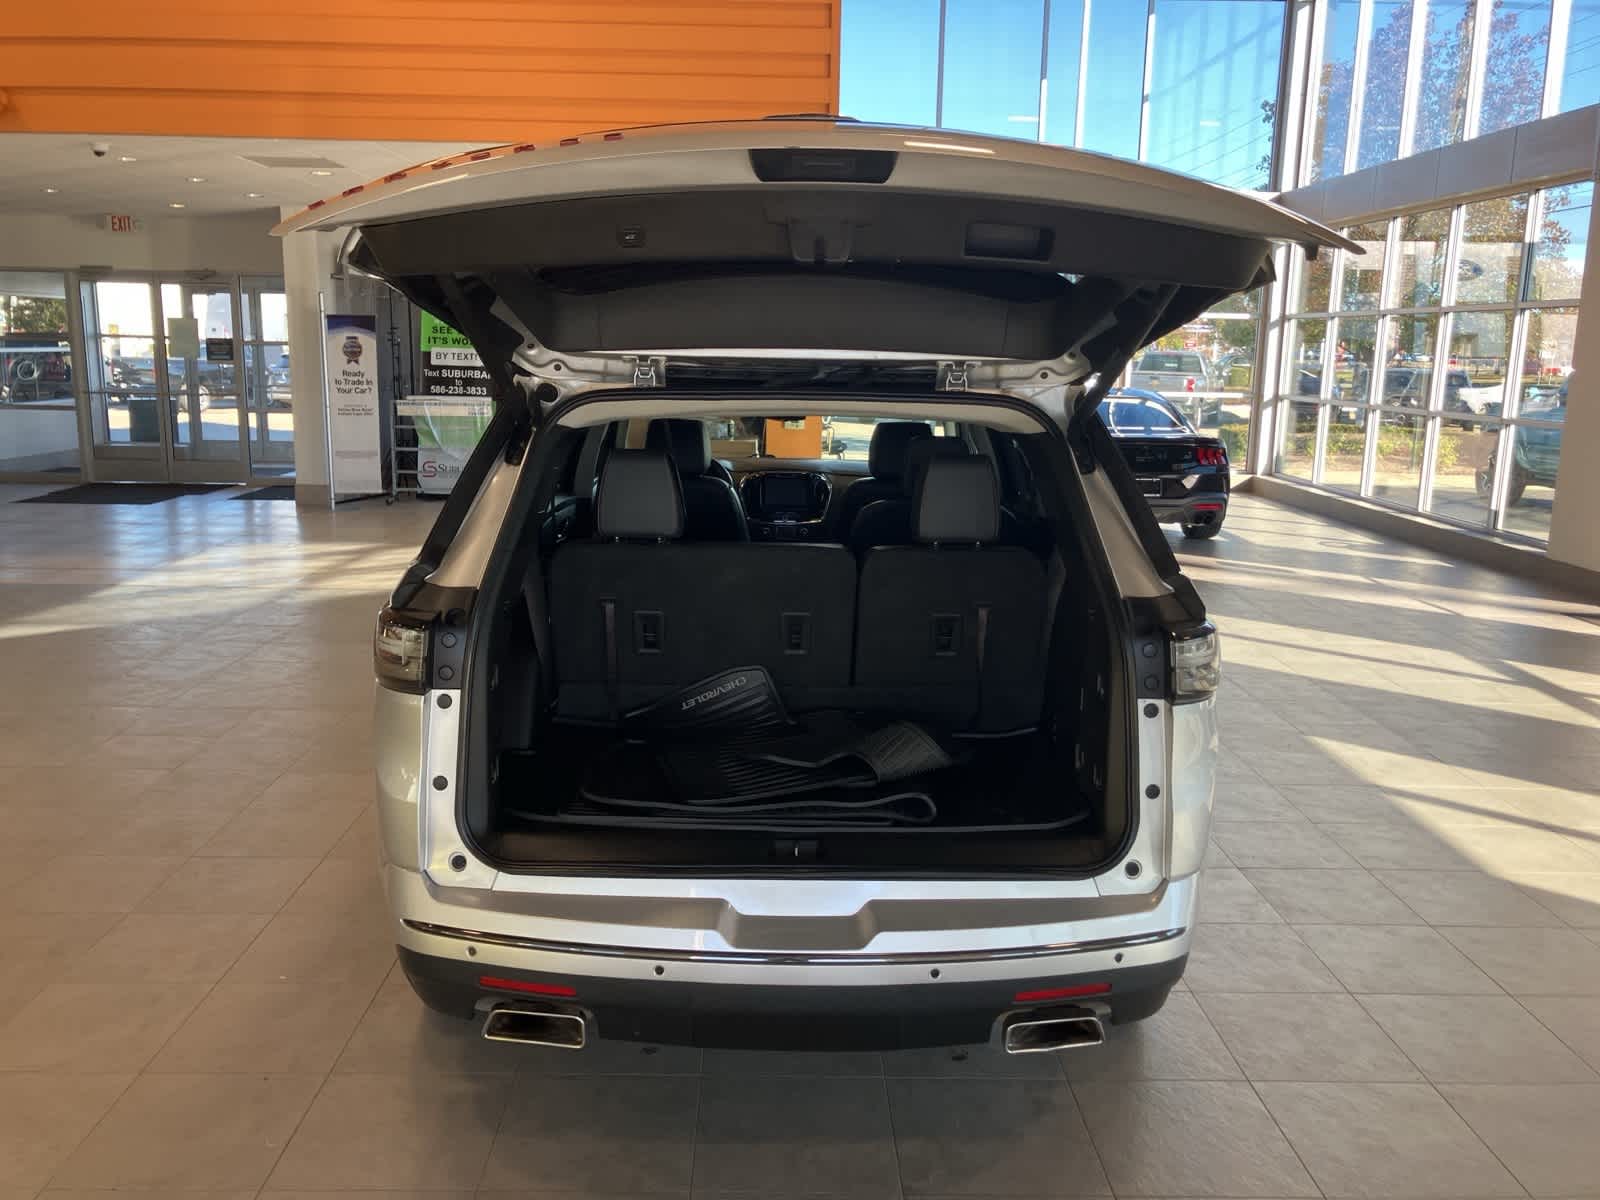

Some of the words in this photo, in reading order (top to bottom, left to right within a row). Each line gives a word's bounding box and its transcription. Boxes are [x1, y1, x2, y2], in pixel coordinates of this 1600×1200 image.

[111, 215, 132, 232] EXIT
[428, 336, 449, 344] IT'S
[451, 336, 472, 346] WO
[435, 352, 449, 360] BY
[343, 369, 366, 379] Ready
[424, 368, 440, 377] Text
[343, 378, 365, 386] Trade
[354, 386, 373, 394] Car?
[680, 676, 747, 711] CHEVROLET
